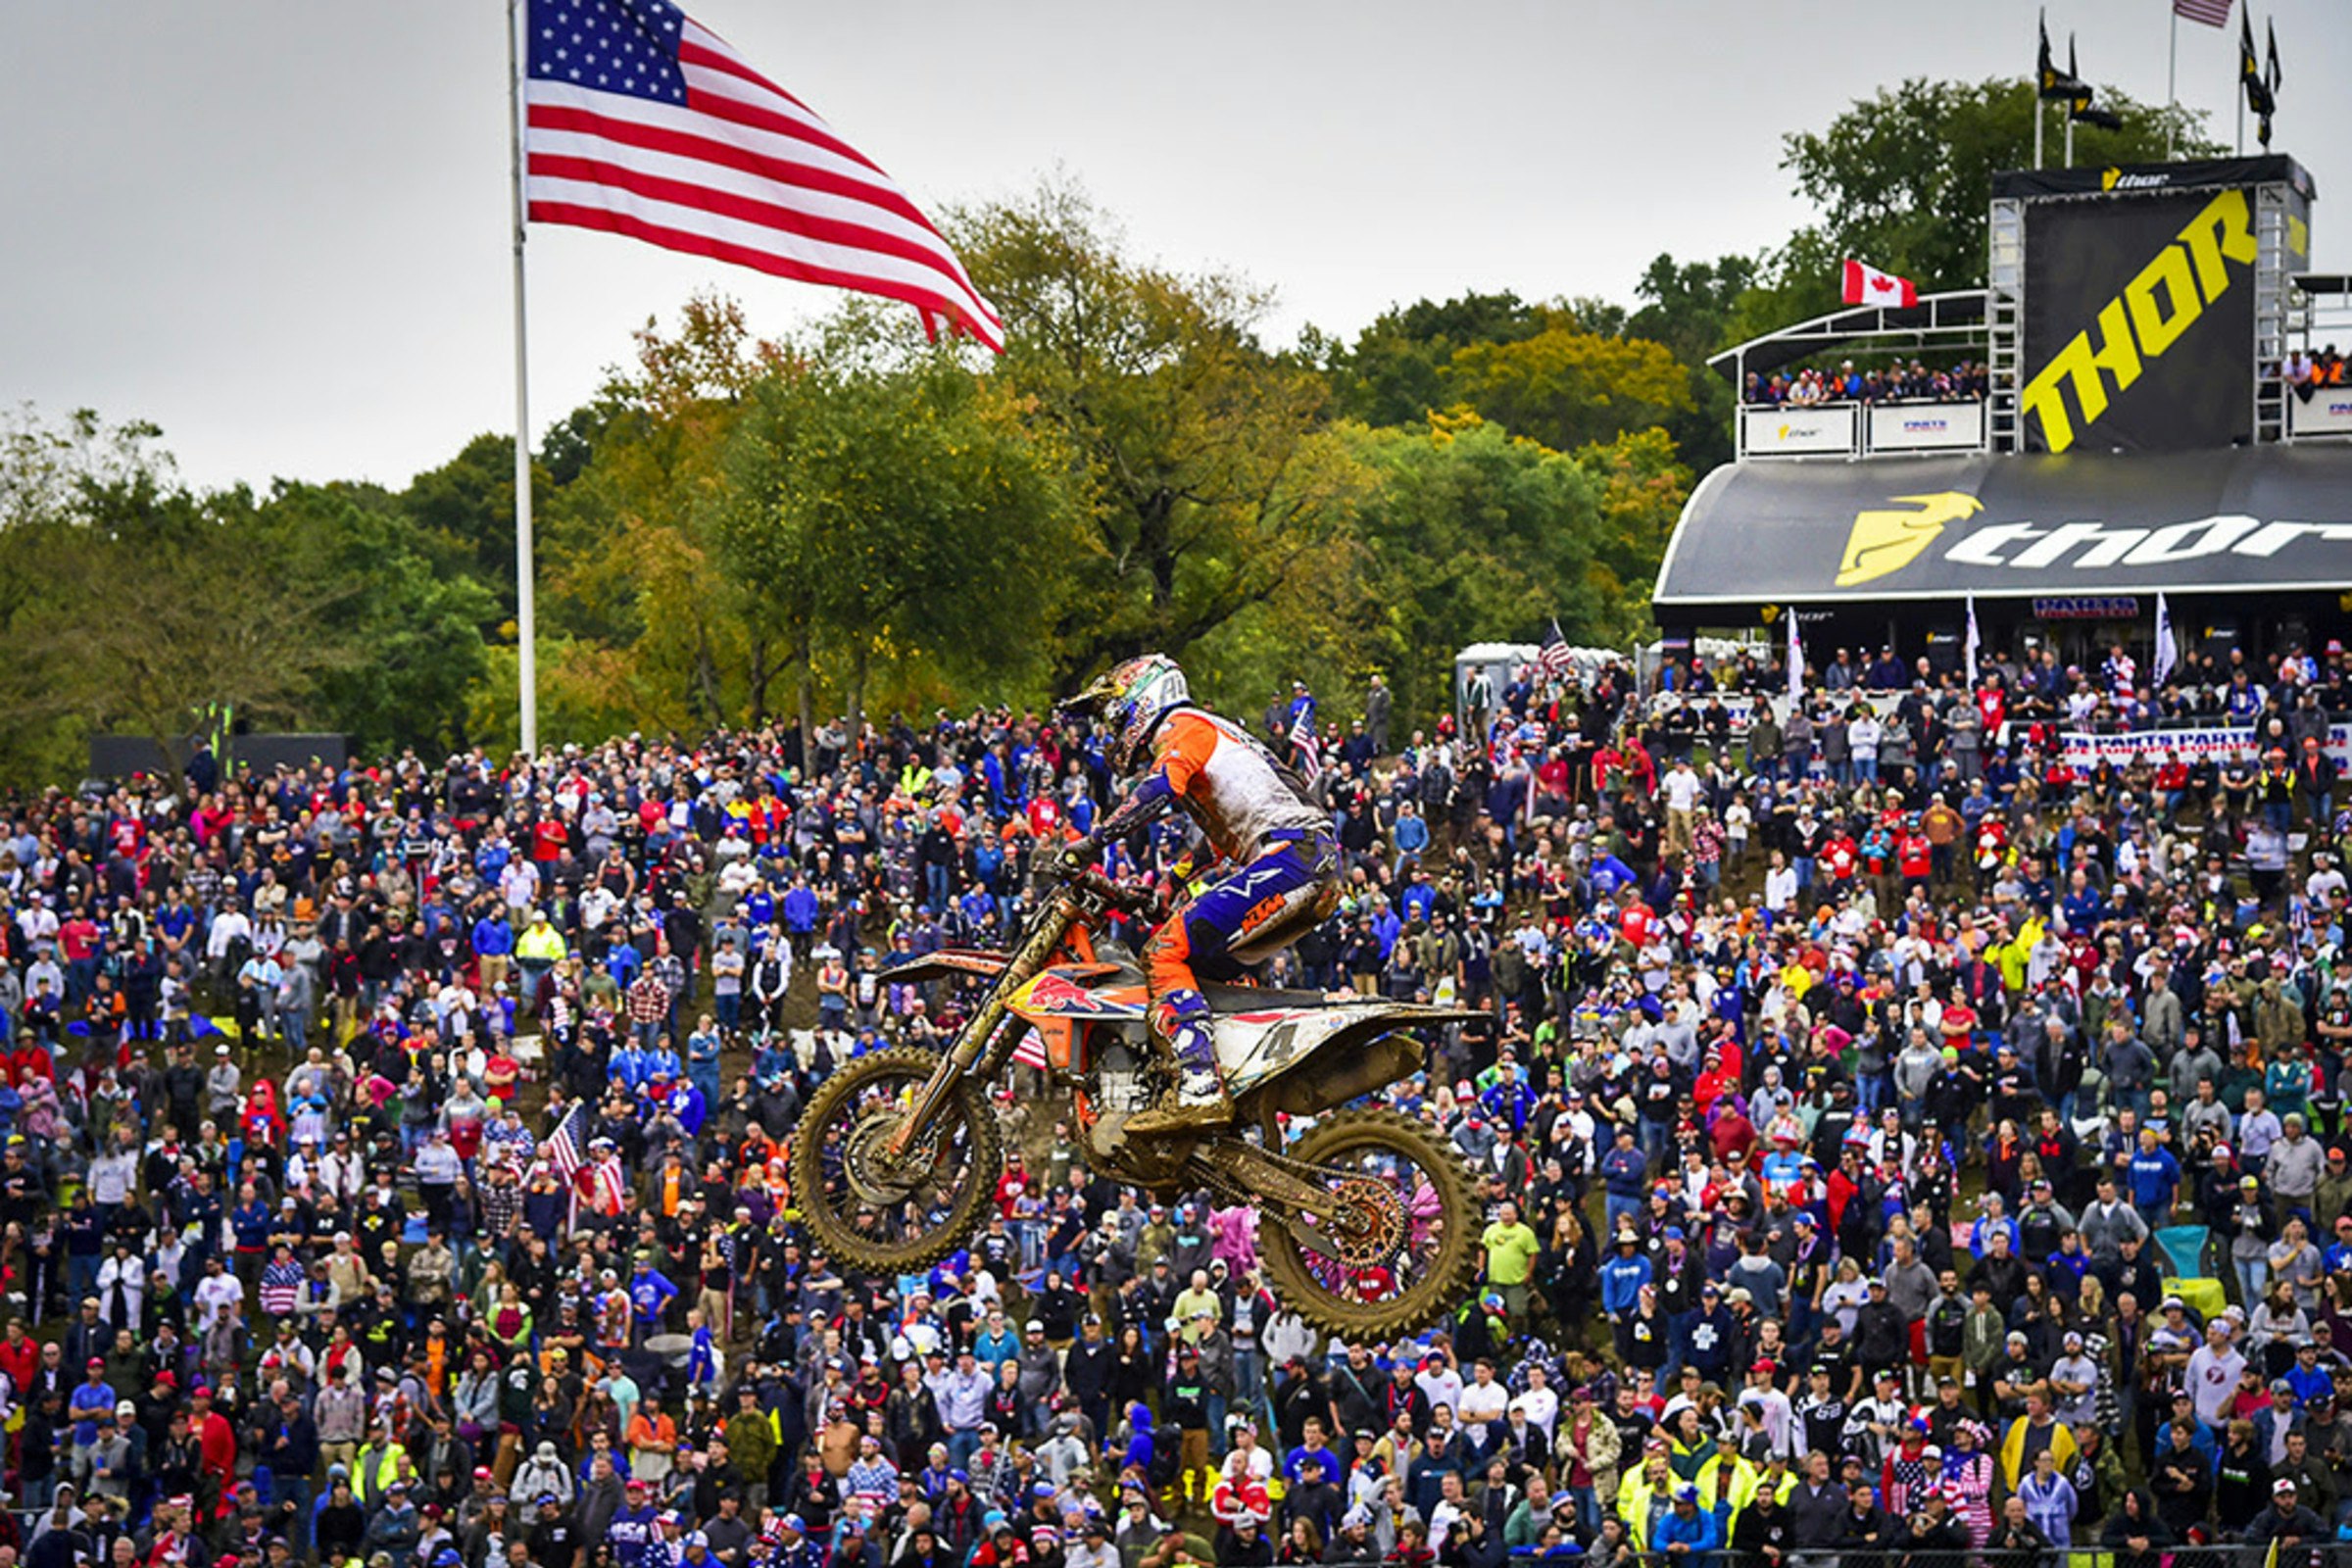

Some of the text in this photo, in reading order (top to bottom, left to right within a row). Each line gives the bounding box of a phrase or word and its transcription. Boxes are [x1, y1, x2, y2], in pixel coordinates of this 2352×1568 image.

[2022, 189, 2258, 454] THOR
[1944, 514, 2352, 568] thor
[1241, 893, 1286, 935] KTM
[1261, 1023, 1298, 1062] 4
